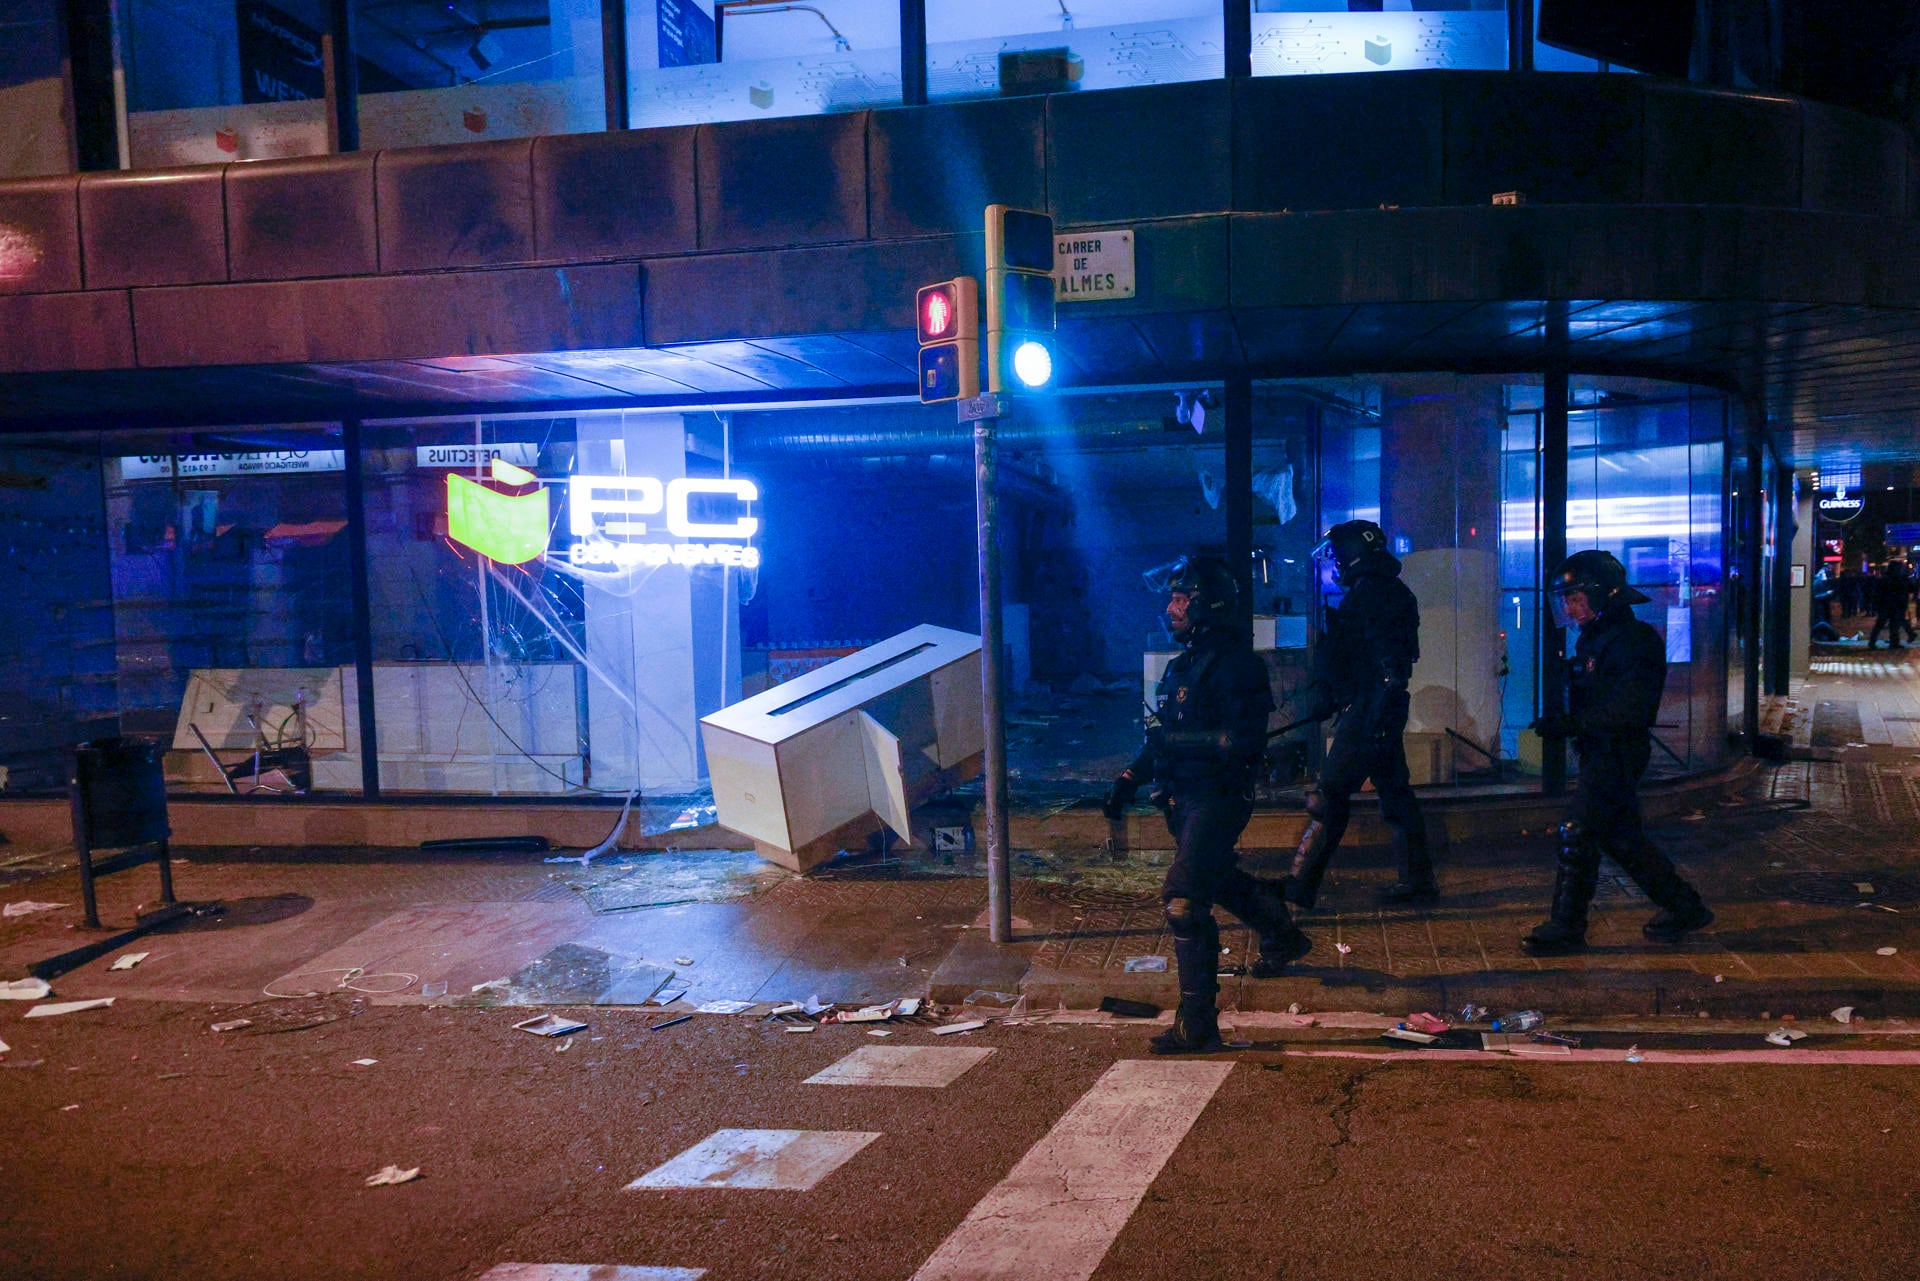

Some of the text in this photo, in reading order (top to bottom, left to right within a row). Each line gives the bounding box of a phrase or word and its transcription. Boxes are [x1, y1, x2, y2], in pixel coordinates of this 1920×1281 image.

[1058, 240, 1102, 255] CARRER
[1074, 258, 1088, 270] DE
[1060, 273, 1115, 293] ALMES
[570, 475, 758, 539] PC
[1819, 499, 1861, 509] GUINNESS
